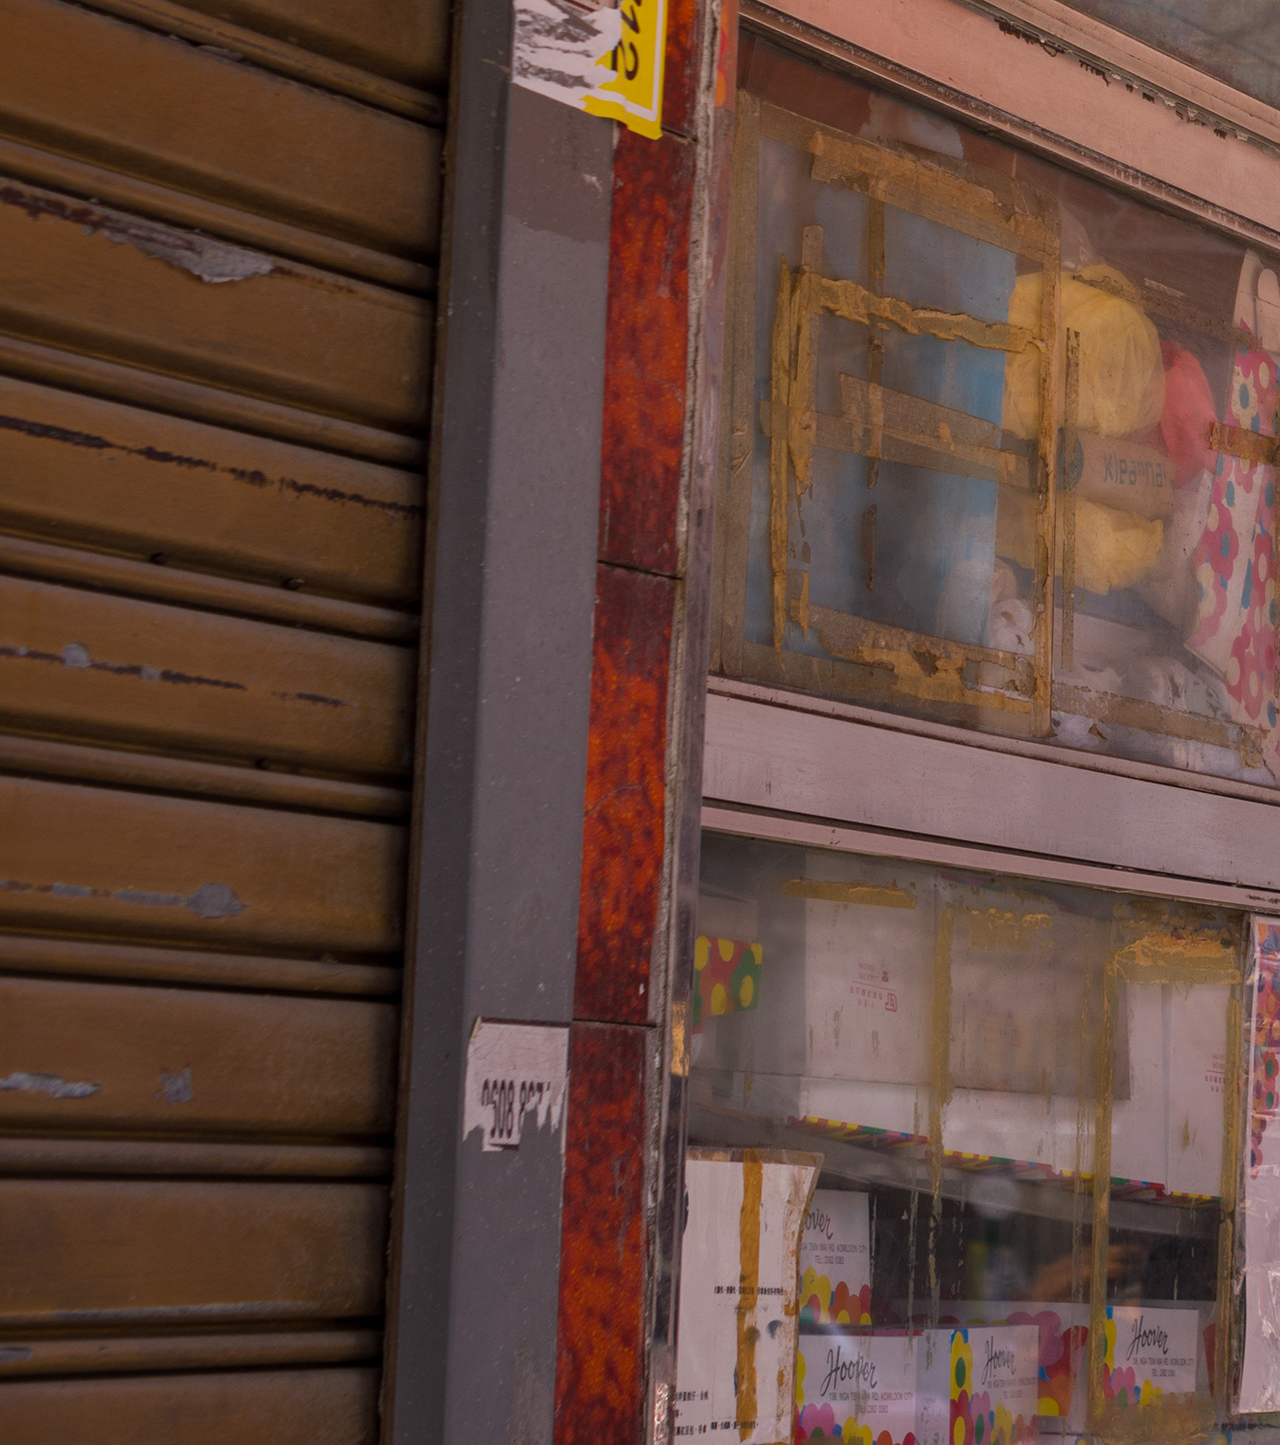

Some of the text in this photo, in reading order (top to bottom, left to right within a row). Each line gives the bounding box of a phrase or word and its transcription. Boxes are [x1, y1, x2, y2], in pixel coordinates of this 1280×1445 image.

[982, 1335, 1017, 1385] Hoover
[1125, 1315, 1170, 1361] Hoover
[820, 1345, 878, 1397] Hoover
[880, 1392, 903, 1401] KOWLOON
[904, 1391, 914, 1401] CITY
